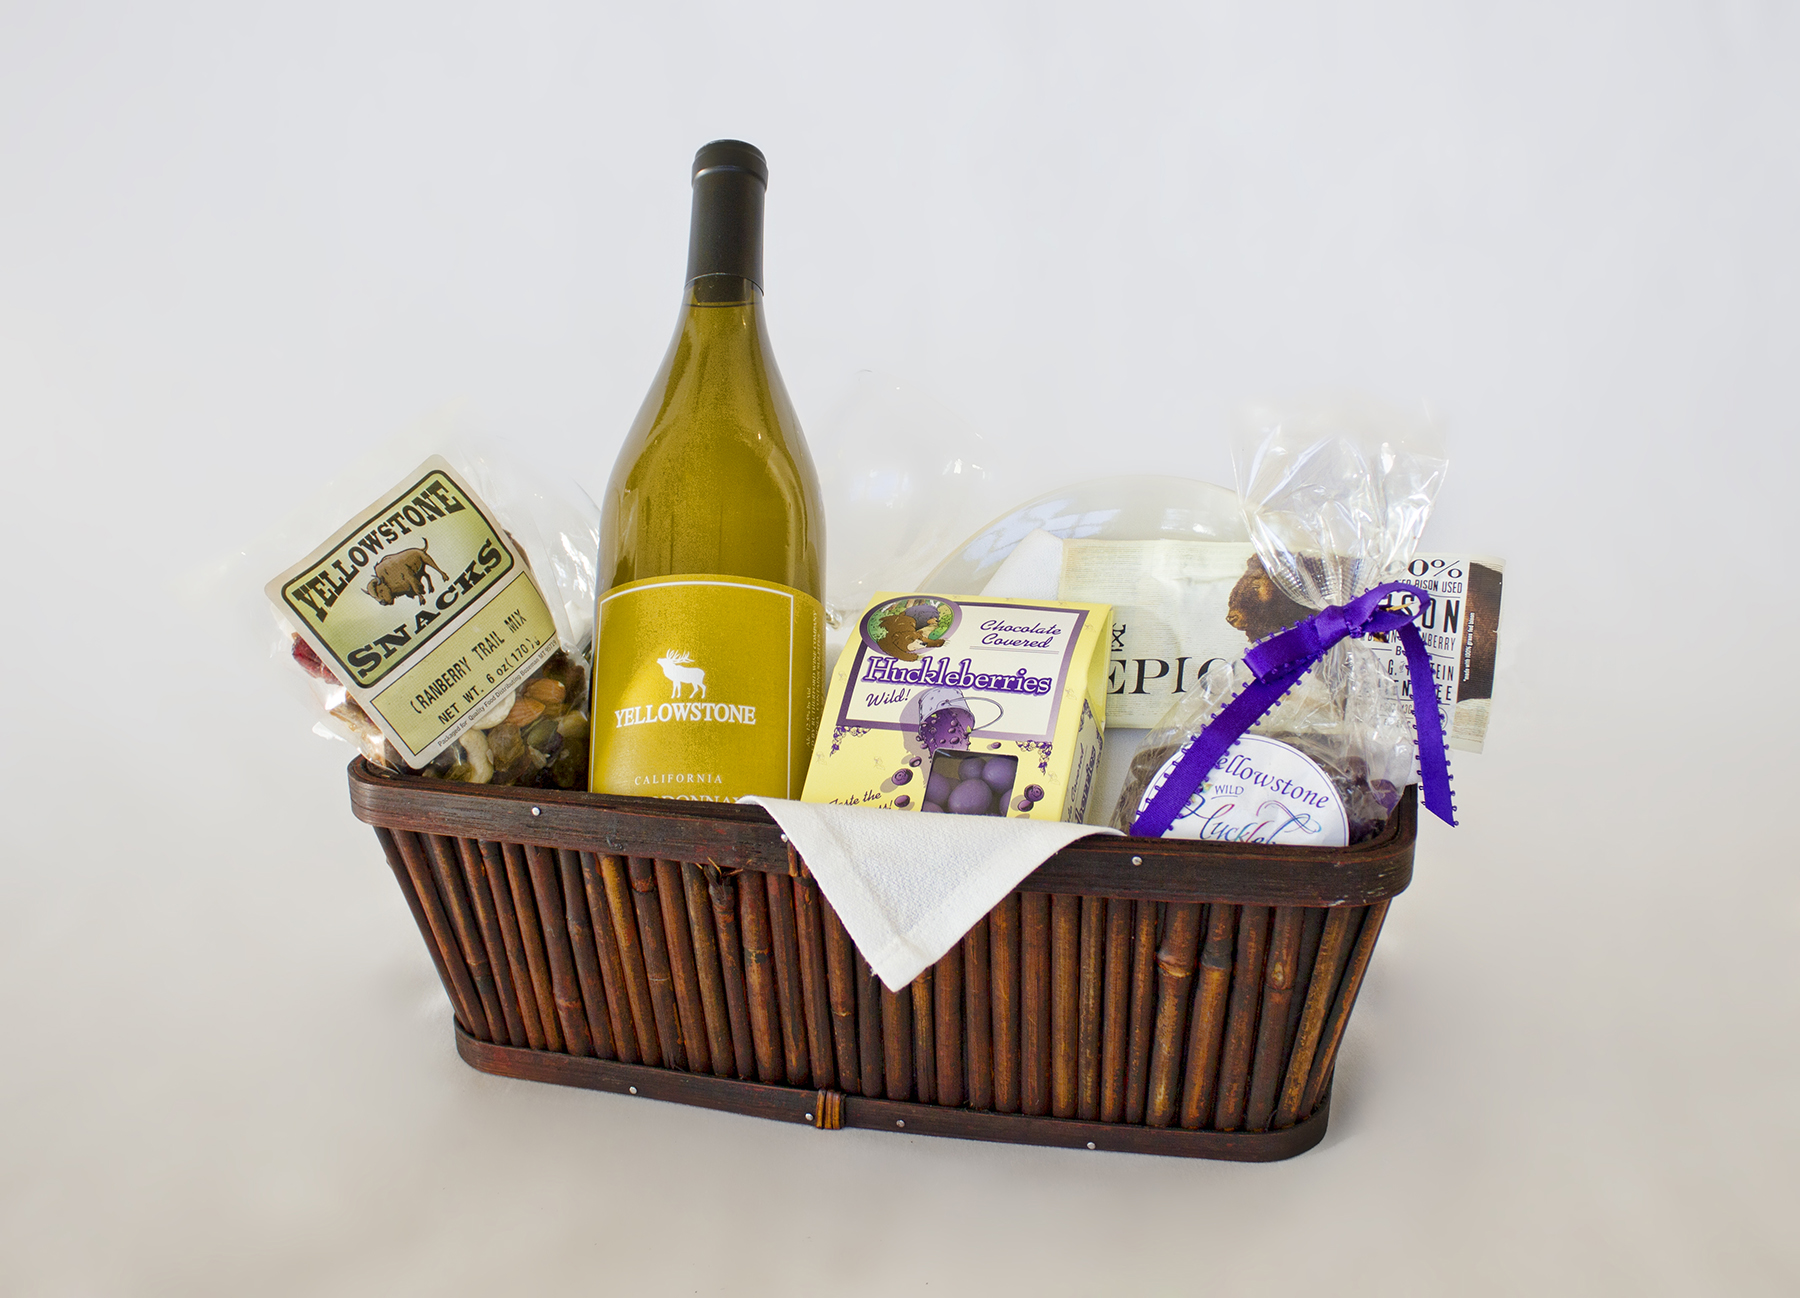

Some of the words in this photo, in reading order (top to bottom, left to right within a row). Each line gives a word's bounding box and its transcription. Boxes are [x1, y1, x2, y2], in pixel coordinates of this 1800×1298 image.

[291, 480, 466, 623] YELLOWSTONE
[1442, 581, 1463, 594] USED
[347, 537, 502, 679] SNACKS
[470, 629, 505, 661] TRAIL
[503, 608, 528, 633] MIX
[979, 620, 1062, 636] Chocolate
[981, 633, 1051, 649] Covered
[861, 656, 1053, 696] Huckleberries
[437, 702, 460, 725] NET
[462, 684, 485, 704] WT.
[485, 673, 496, 684] 6
[865, 689, 910, 707] Wild!
[437, 726, 461, 747] Packaged
[460, 720, 468, 729] for
[468, 705, 486, 721] Quality
[484, 696, 497, 708] Food
[614, 702, 756, 728] YELLOWSTONE
[634, 773, 723, 786] CALIFORNIA
[1214, 784, 1244, 796] WILD
[1216, 754, 1329, 809] ellowstone
[862, 789, 882, 803] the
